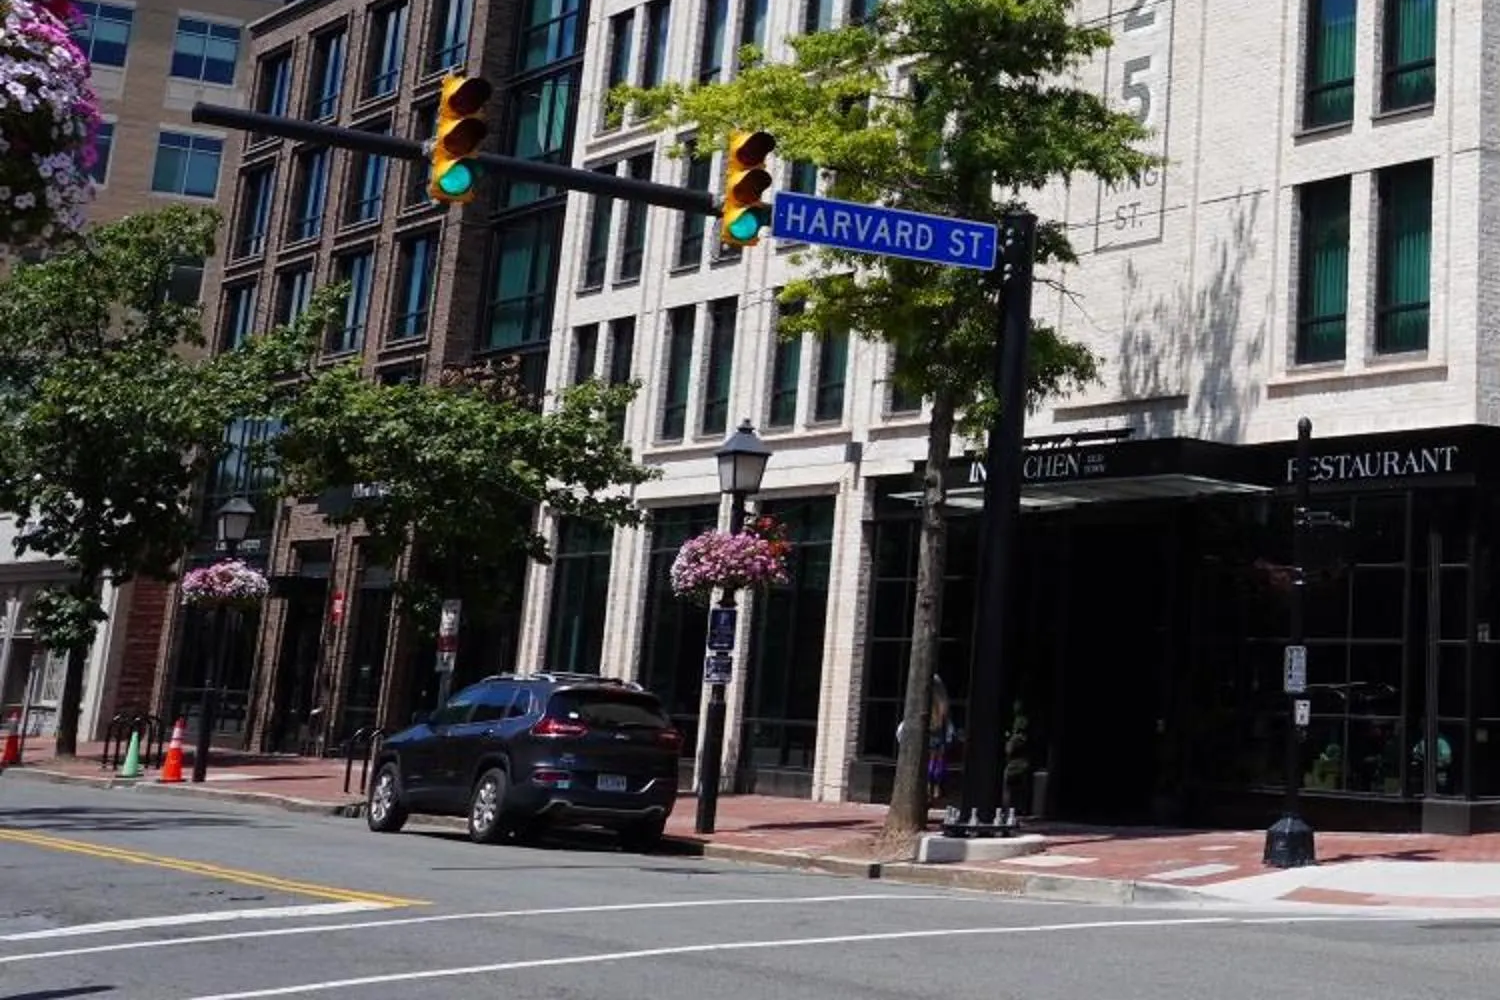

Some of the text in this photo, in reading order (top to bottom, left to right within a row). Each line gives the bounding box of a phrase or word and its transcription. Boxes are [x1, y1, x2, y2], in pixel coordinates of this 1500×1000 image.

[1115, 201, 1143, 230] ST.
[785, 203, 983, 260] HARVARD ST
[1023, 452, 1080, 479] CHEN
